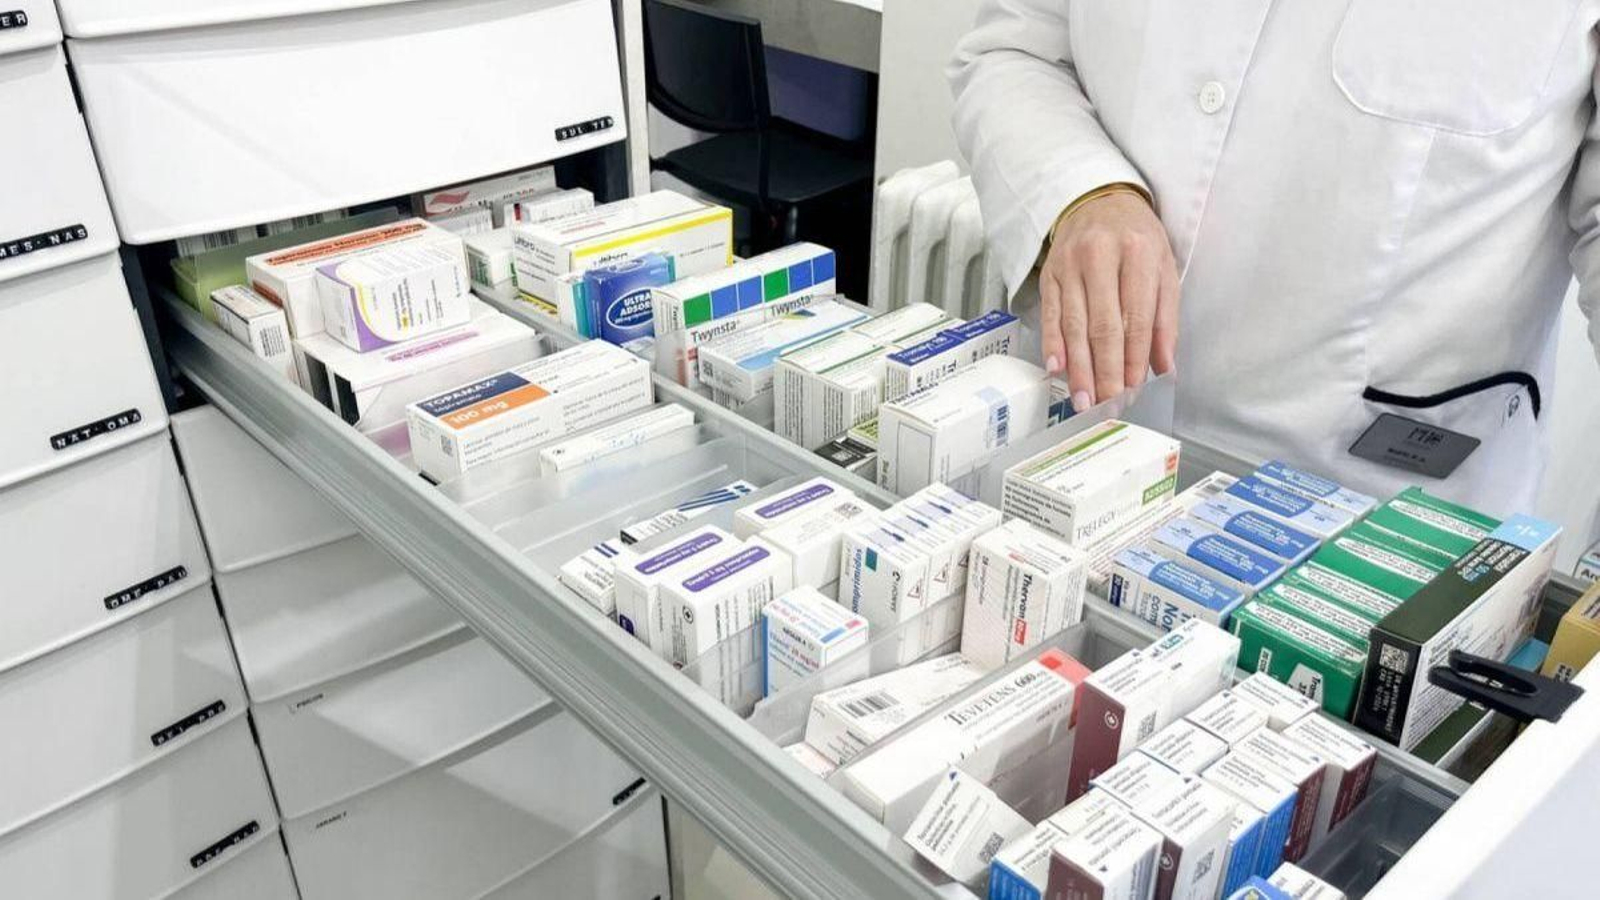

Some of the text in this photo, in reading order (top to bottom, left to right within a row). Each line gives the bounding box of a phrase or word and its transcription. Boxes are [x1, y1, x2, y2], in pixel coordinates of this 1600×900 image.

[623, 289, 651, 306] ULTRA
[771, 295, 815, 317] Twynsta
[619, 301, 652, 318] ADSOR
[690, 321, 738, 343] Twynsta
[449, 400, 510, 424] 100 mg
[852, 548, 862, 613] omprimidos
[946, 683, 1015, 726] TEVETENS
[1015, 673, 1037, 688] 600
